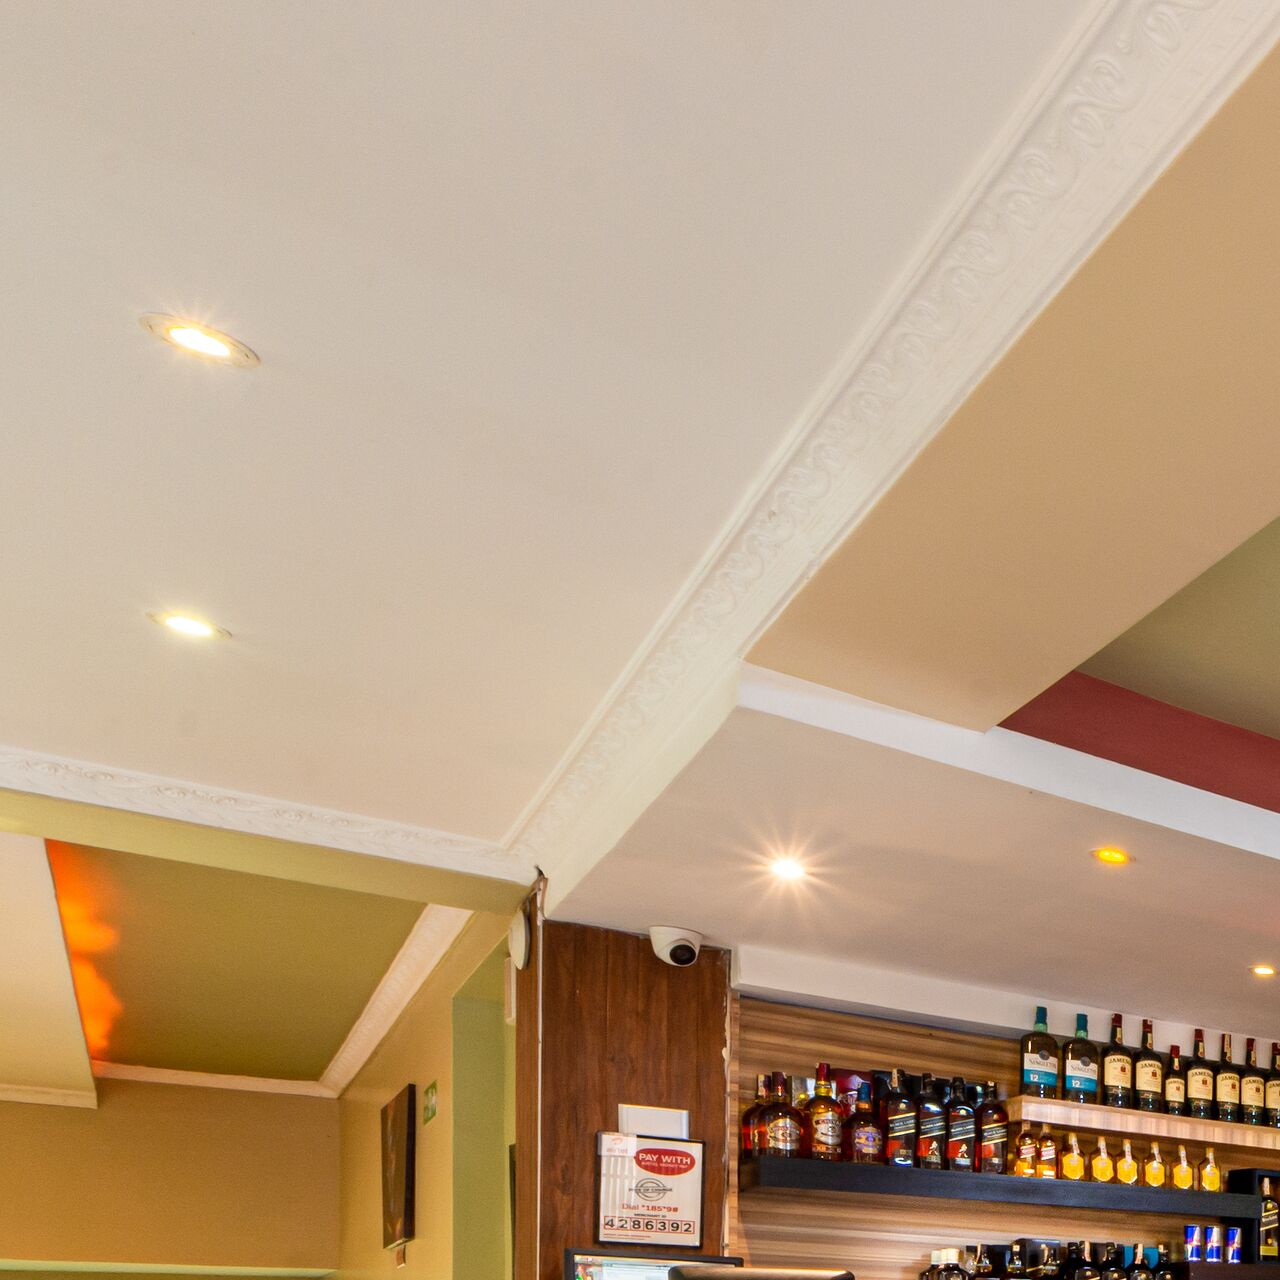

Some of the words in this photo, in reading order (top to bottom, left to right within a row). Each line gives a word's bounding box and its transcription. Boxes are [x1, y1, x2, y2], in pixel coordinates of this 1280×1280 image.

[639, 1153, 659, 1161] PAY
[661, 1155, 690, 1165] WITH
[605, 1218, 692, 1233] 4286392
